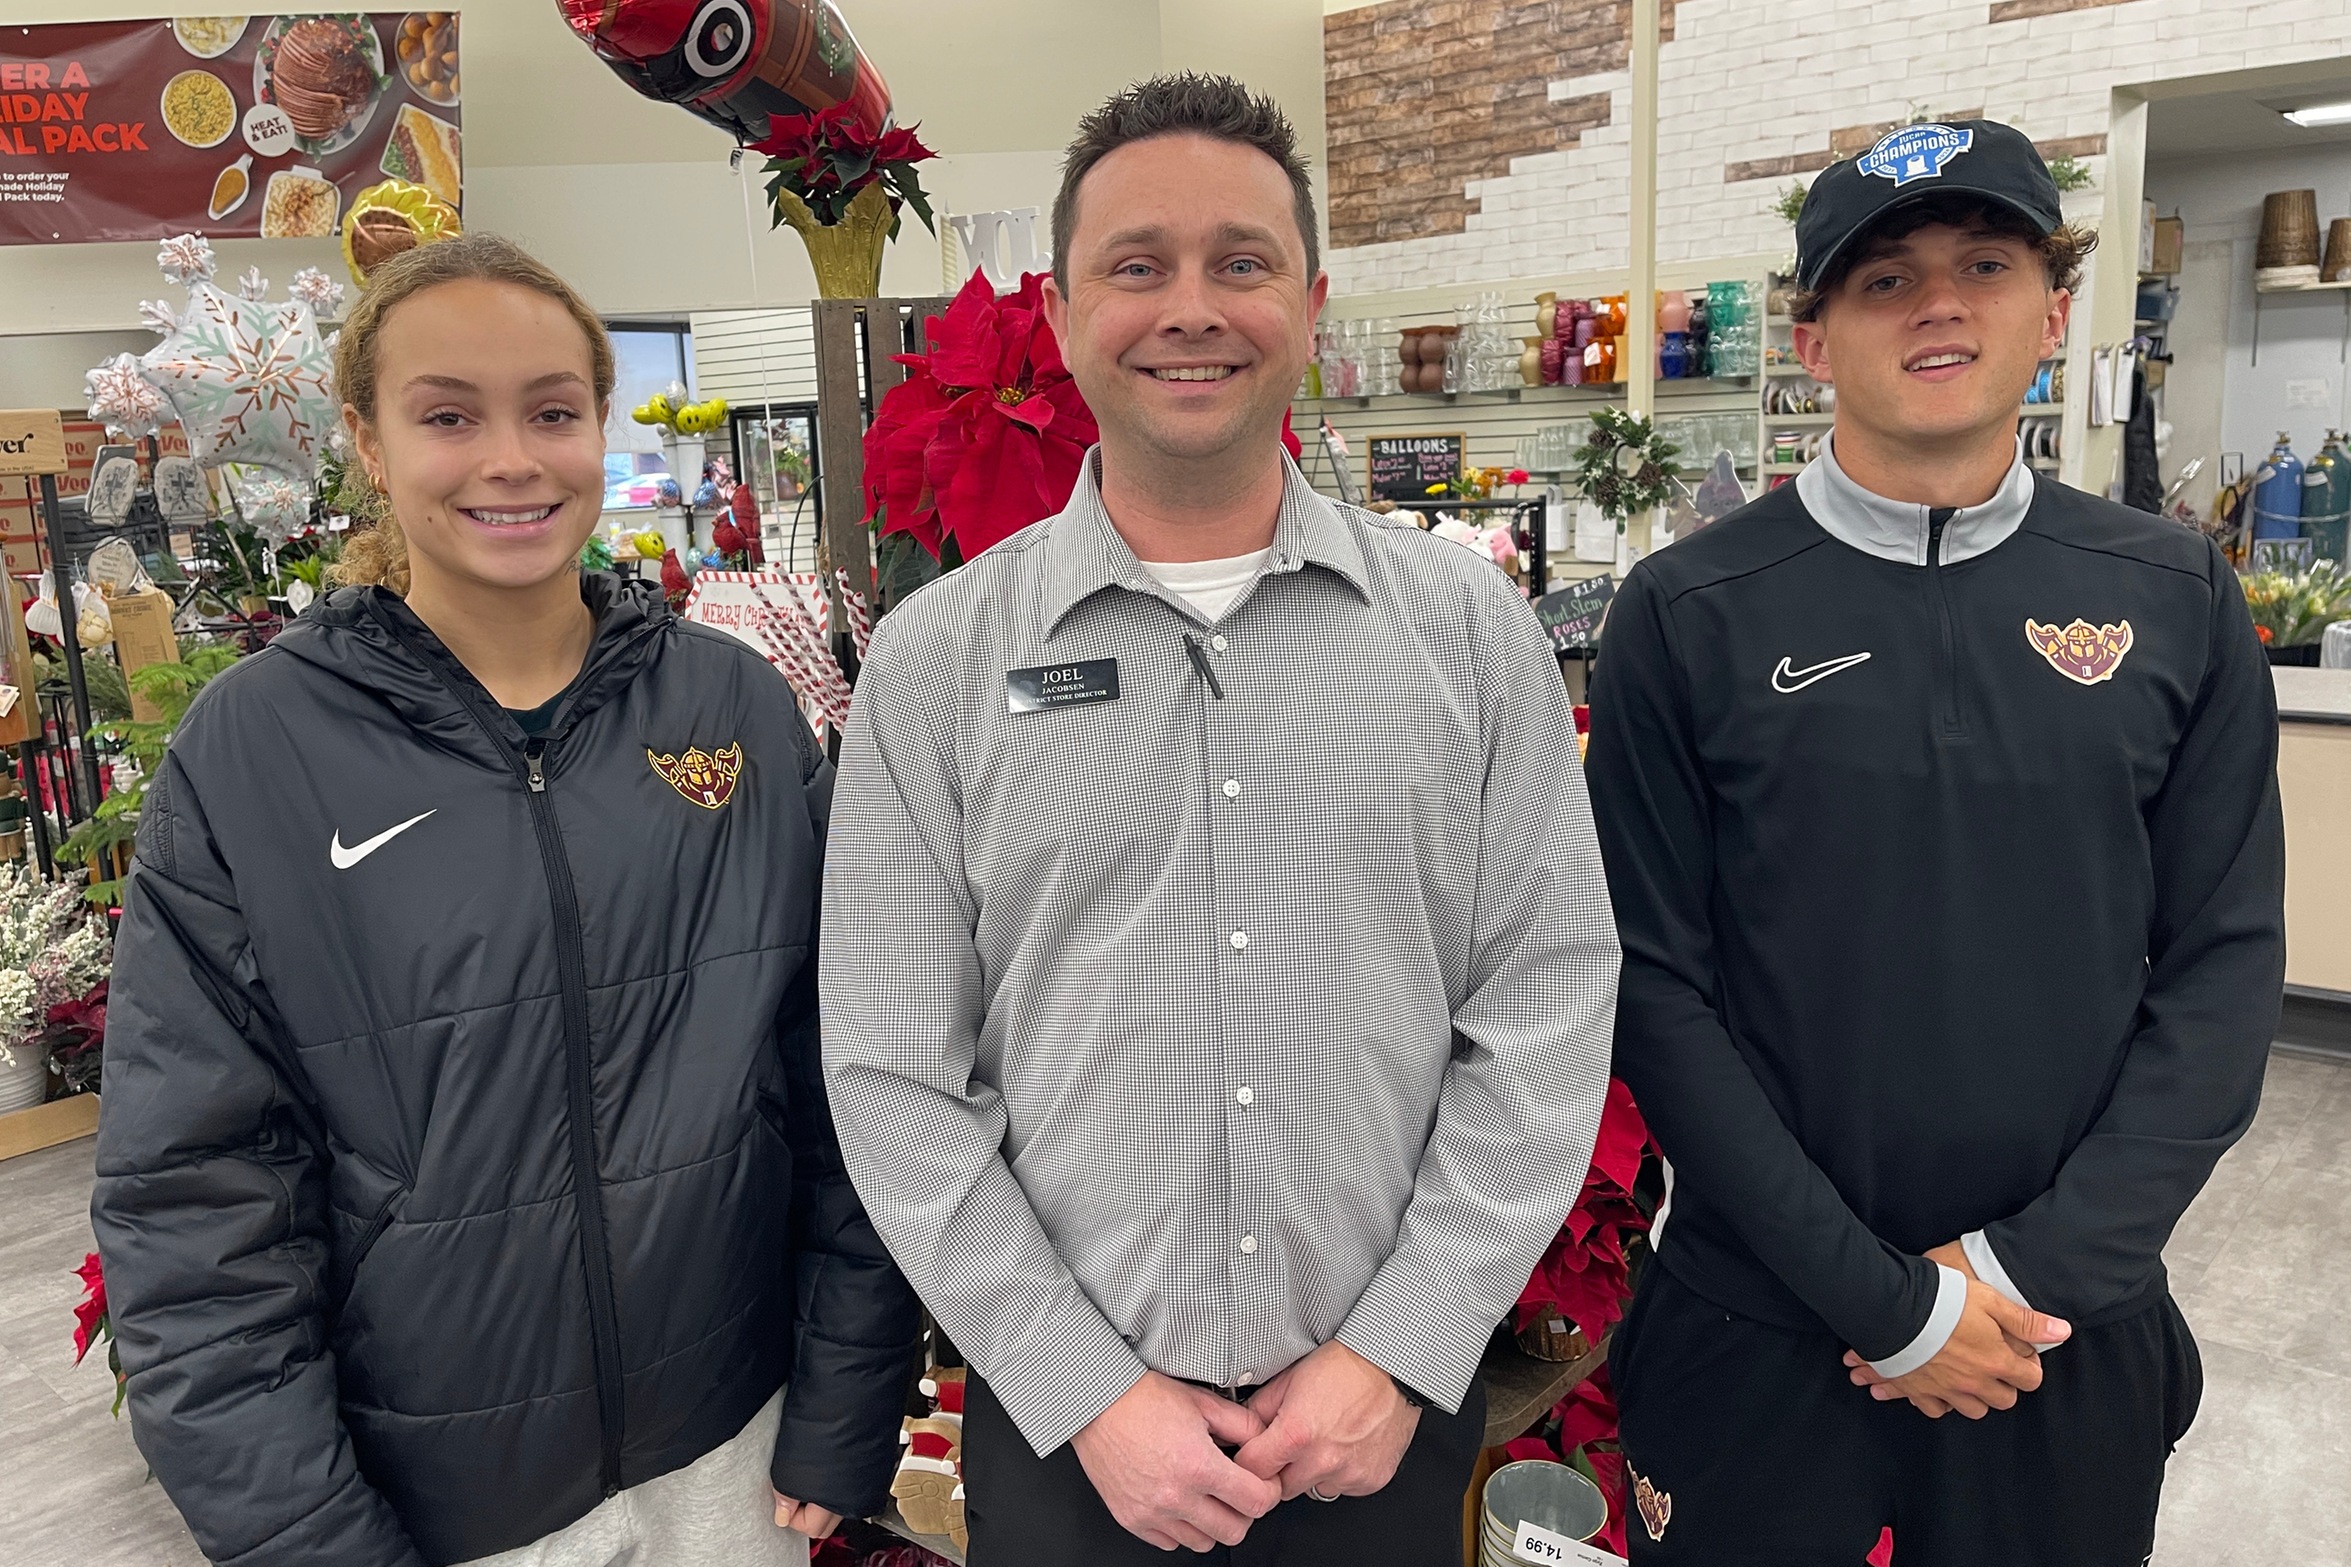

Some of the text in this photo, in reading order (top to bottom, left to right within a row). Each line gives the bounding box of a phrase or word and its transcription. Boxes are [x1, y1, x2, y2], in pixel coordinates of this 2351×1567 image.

[60, 61, 91, 89] A
[0, 92, 89, 122] IDAY
[250, 116, 280, 131] HEAT
[41, 122, 149, 154] PACK
[1869, 133, 1960, 169] CHAMPIONS
[3, 172, 15, 180] to
[17, 172, 45, 180] order
[47, 173, 70, 182] your
[26, 181, 65, 192] Holiday
[4, 193, 30, 201] Pack
[33, 192, 65, 202] today.
[1380, 438, 1449, 454] BALLOONS
[701, 602, 742, 631] MERRY
[1553, 615, 1591, 639] ROSES
[1041, 668, 1083, 685] JOEL
[1042, 683, 1085, 694] JACOBSEN
[1052, 693, 1073, 701] STORE
[1074, 689, 1107, 699] DIRECTOR
[1525, 1537, 1562, 1560] 14.99
